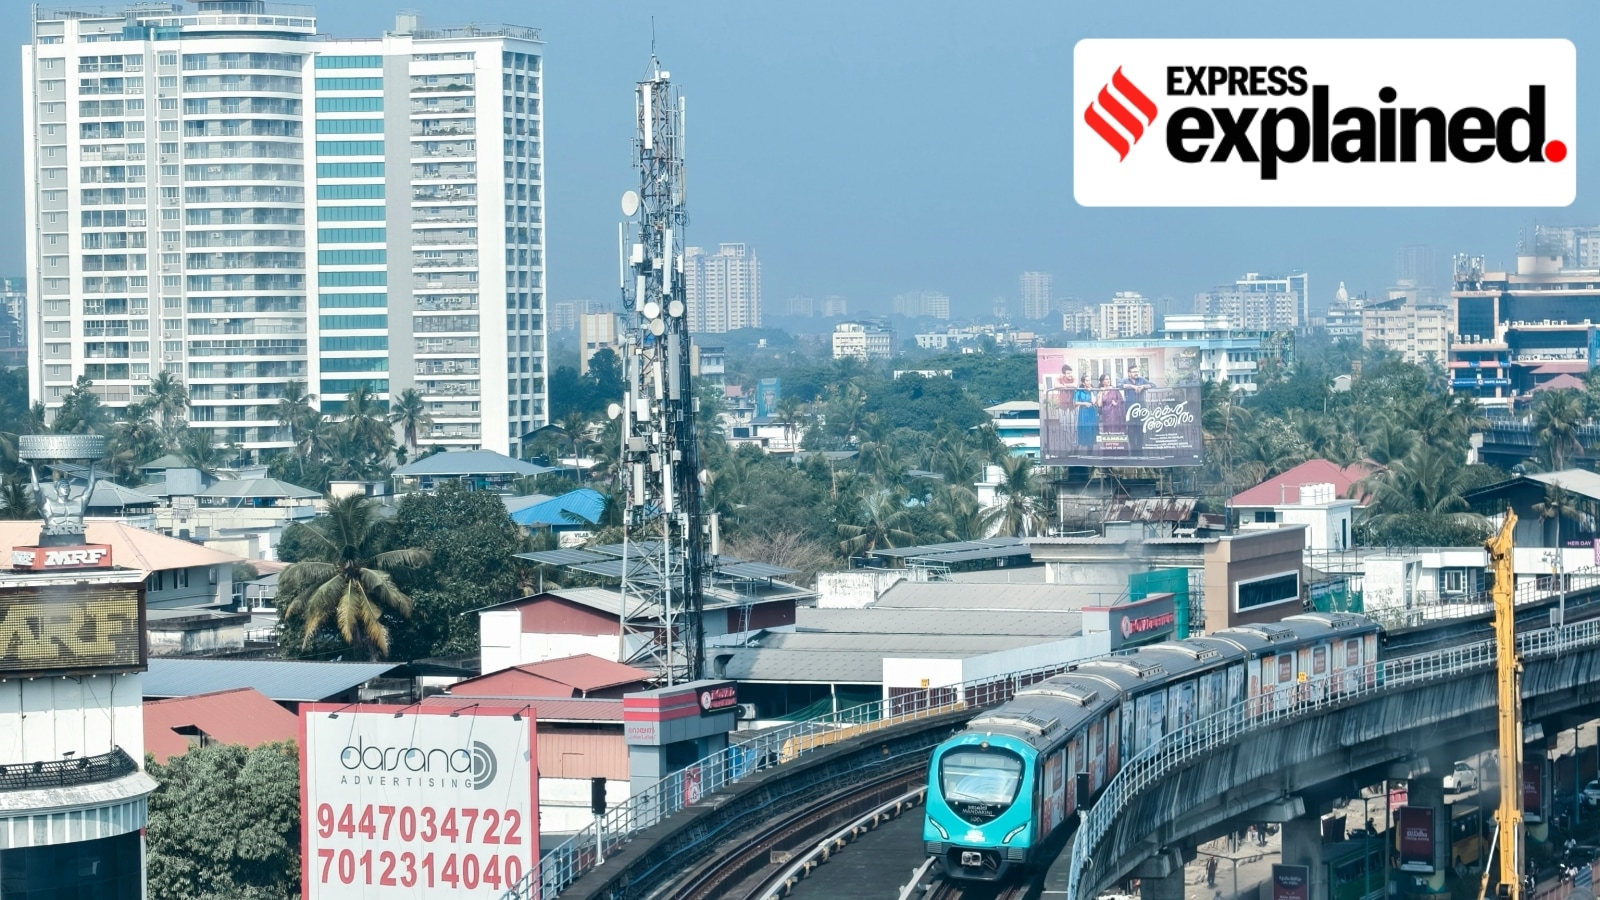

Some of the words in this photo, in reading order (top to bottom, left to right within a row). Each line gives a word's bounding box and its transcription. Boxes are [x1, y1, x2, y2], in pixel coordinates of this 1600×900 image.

[46, 525, 88, 535] MRF
[44, 548, 107, 566] MRF
[340, 735, 472, 773] darsana
[340, 775, 472, 789] ADVERTISING
[317, 802, 522, 845] 9447034722
[317, 848, 522, 891] 7012314040
